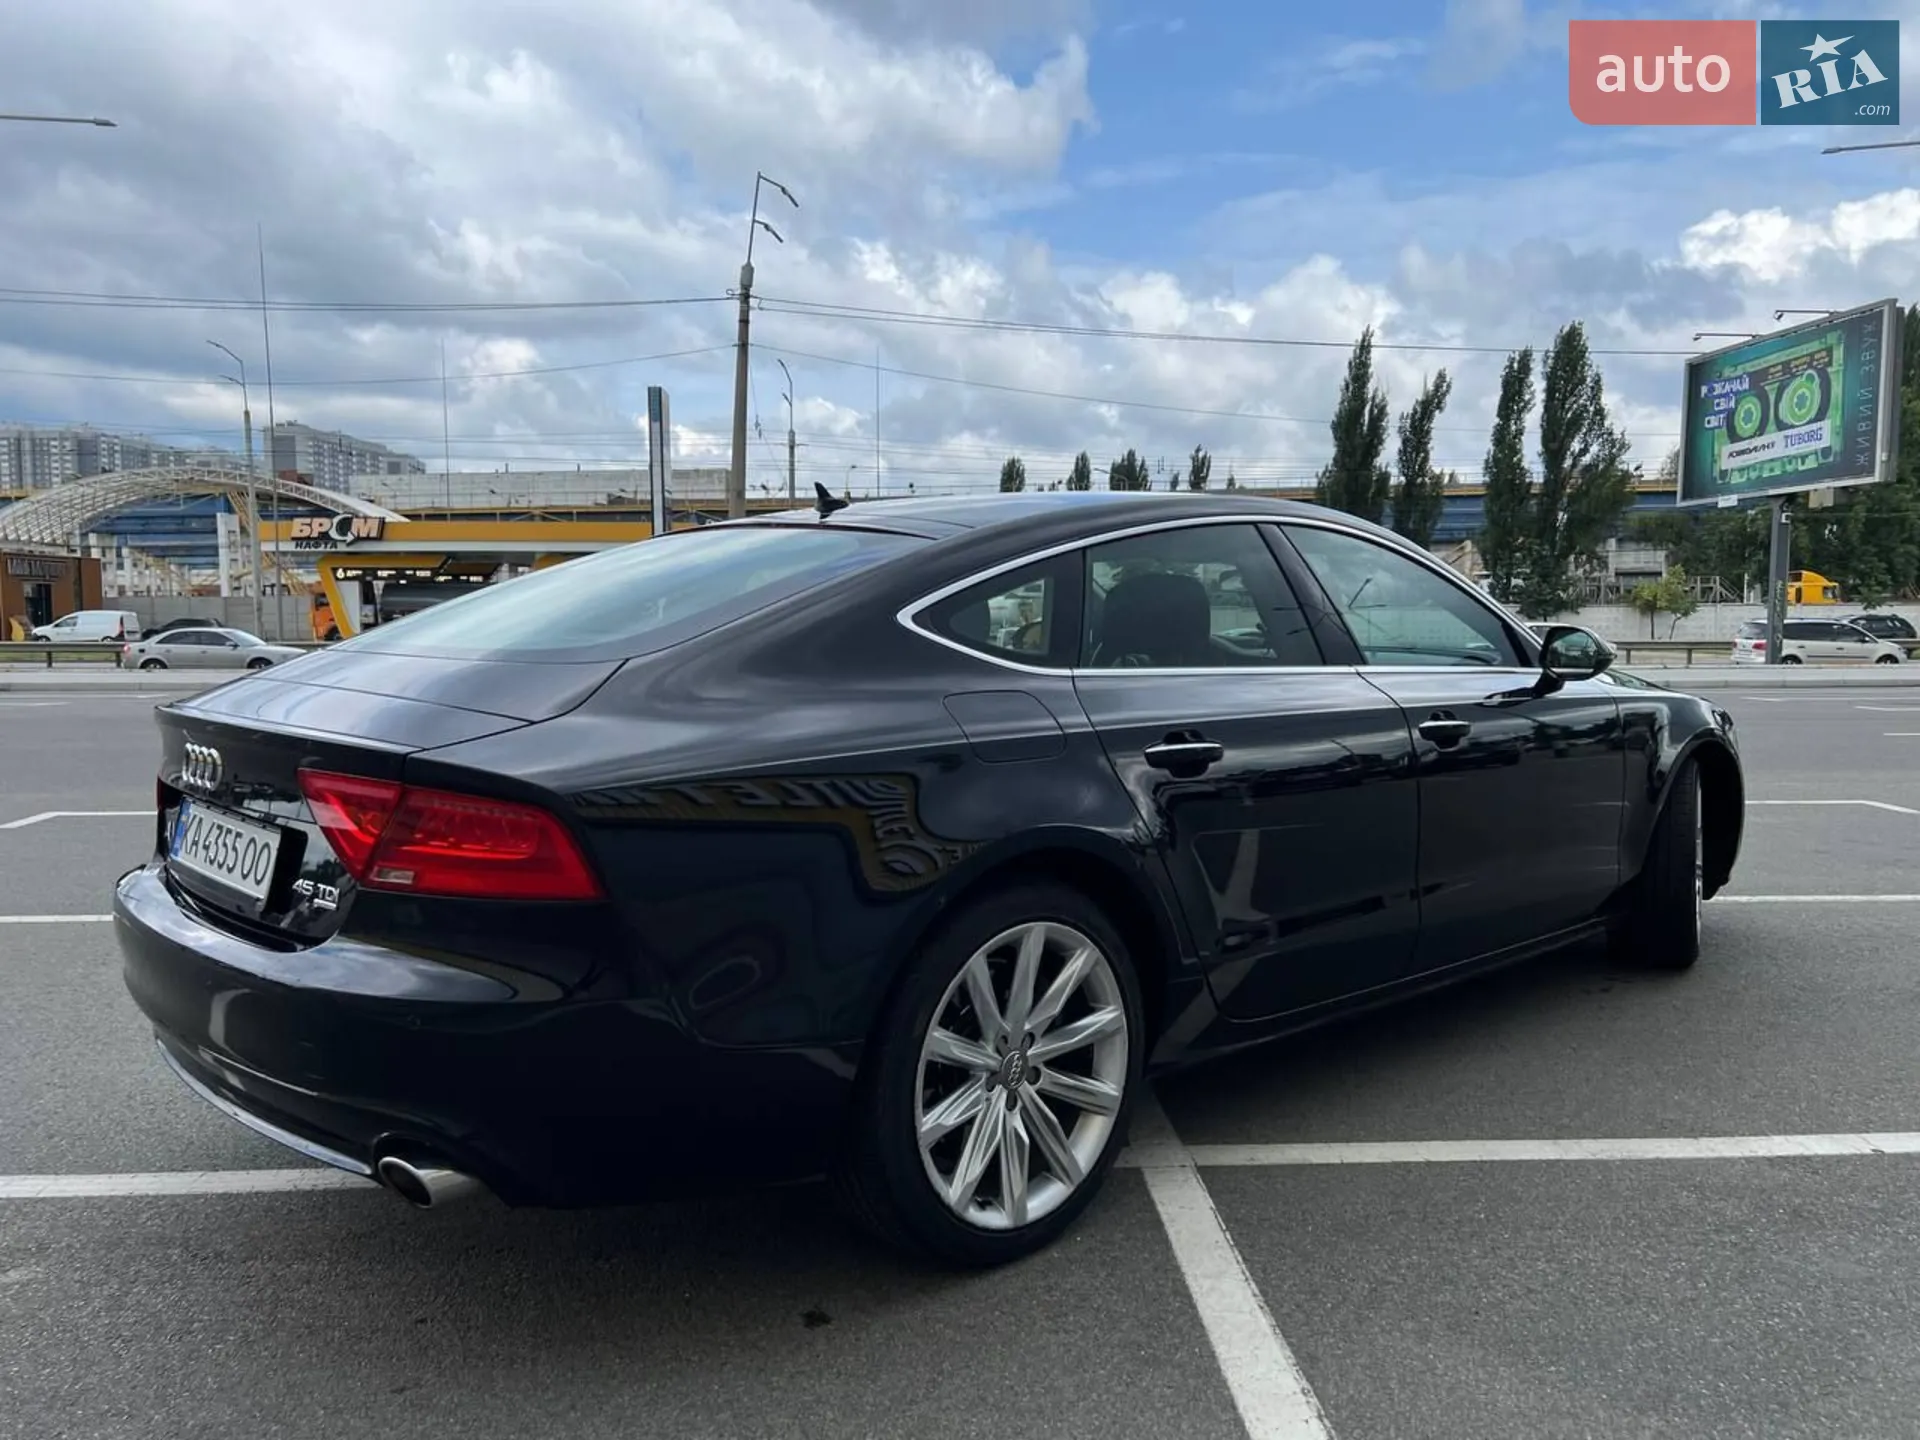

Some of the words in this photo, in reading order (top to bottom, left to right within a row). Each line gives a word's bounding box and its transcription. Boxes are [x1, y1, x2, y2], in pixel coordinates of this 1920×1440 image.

[1783, 427, 1823, 448] TUBORG
[1855, 386, 1874, 467] ЖИВИЙ
[291, 514, 385, 544] БРСМ
[294, 540, 338, 550] НАФТА
[182, 812, 204, 858] KA
[202, 821, 244, 874] 4355
[292, 878, 315, 896] 45
[316, 883, 340, 903] TDI
